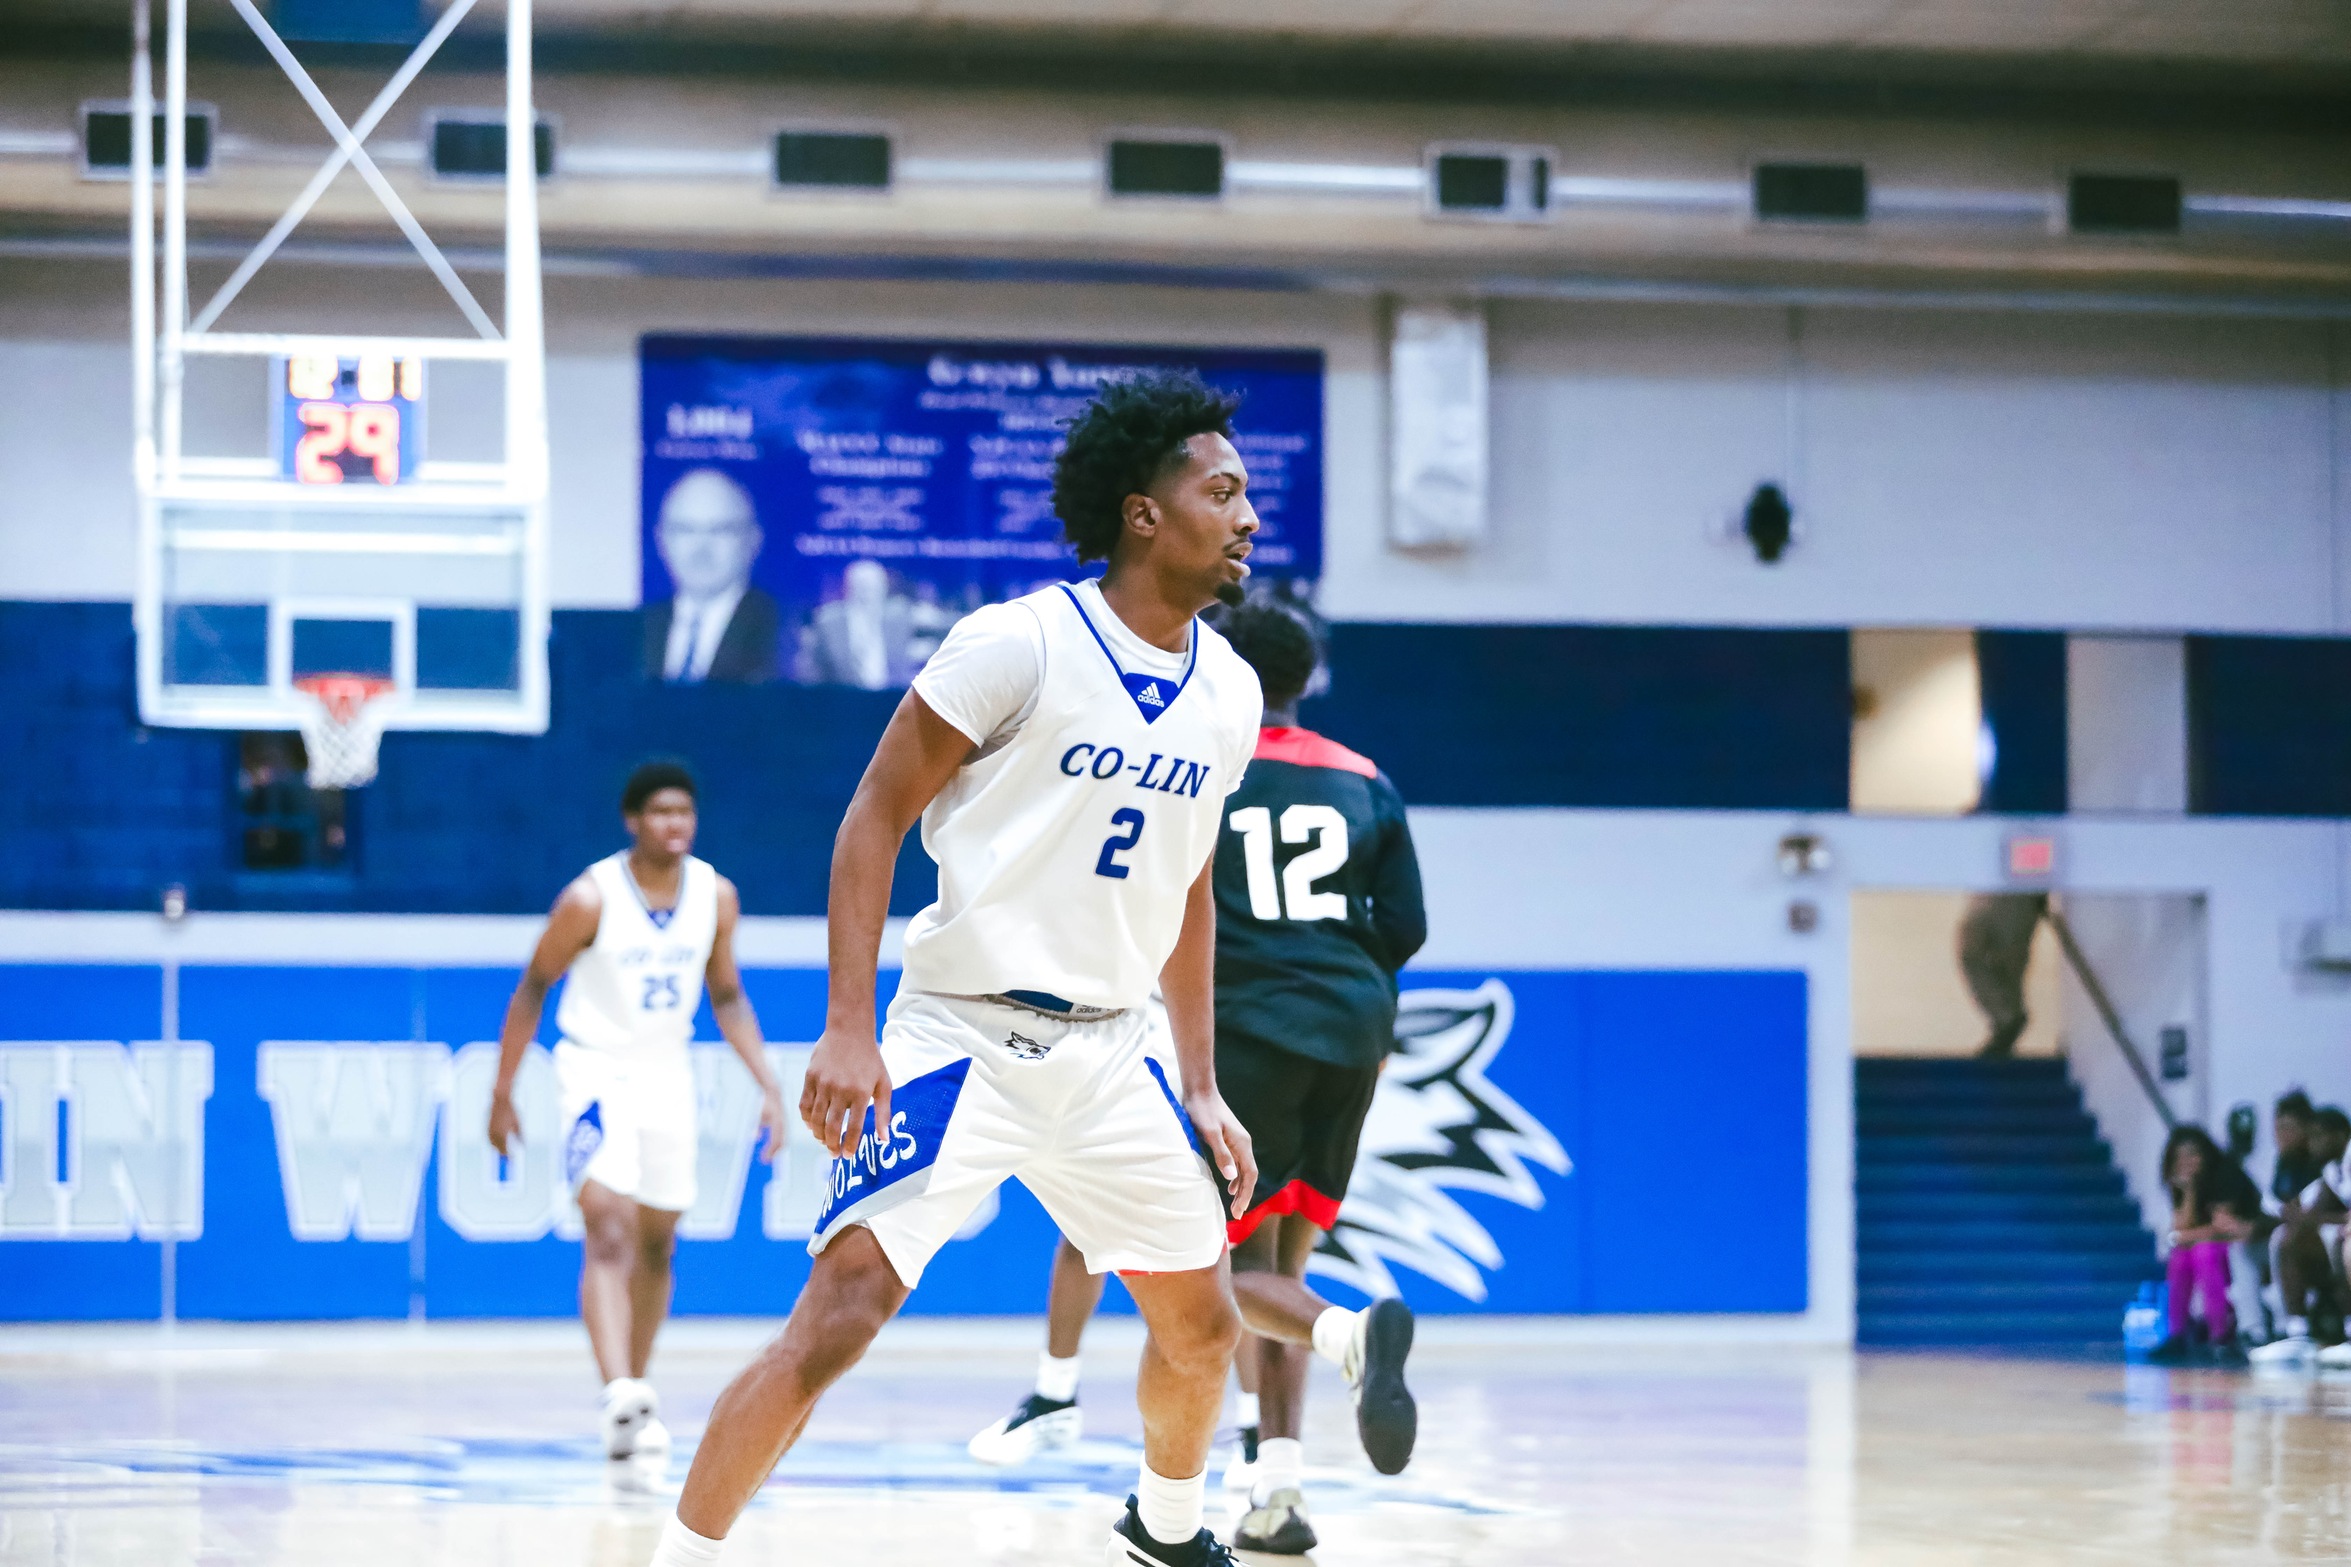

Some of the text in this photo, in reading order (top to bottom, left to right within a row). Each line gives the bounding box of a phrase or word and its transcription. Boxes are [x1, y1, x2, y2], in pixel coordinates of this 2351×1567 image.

[296, 402, 400, 486] 29
[1060, 743, 1211, 798] CO-LIN
[1095, 807, 1145, 879] 2
[1229, 804, 1349, 921] 12
[642, 974, 680, 1010] 25
